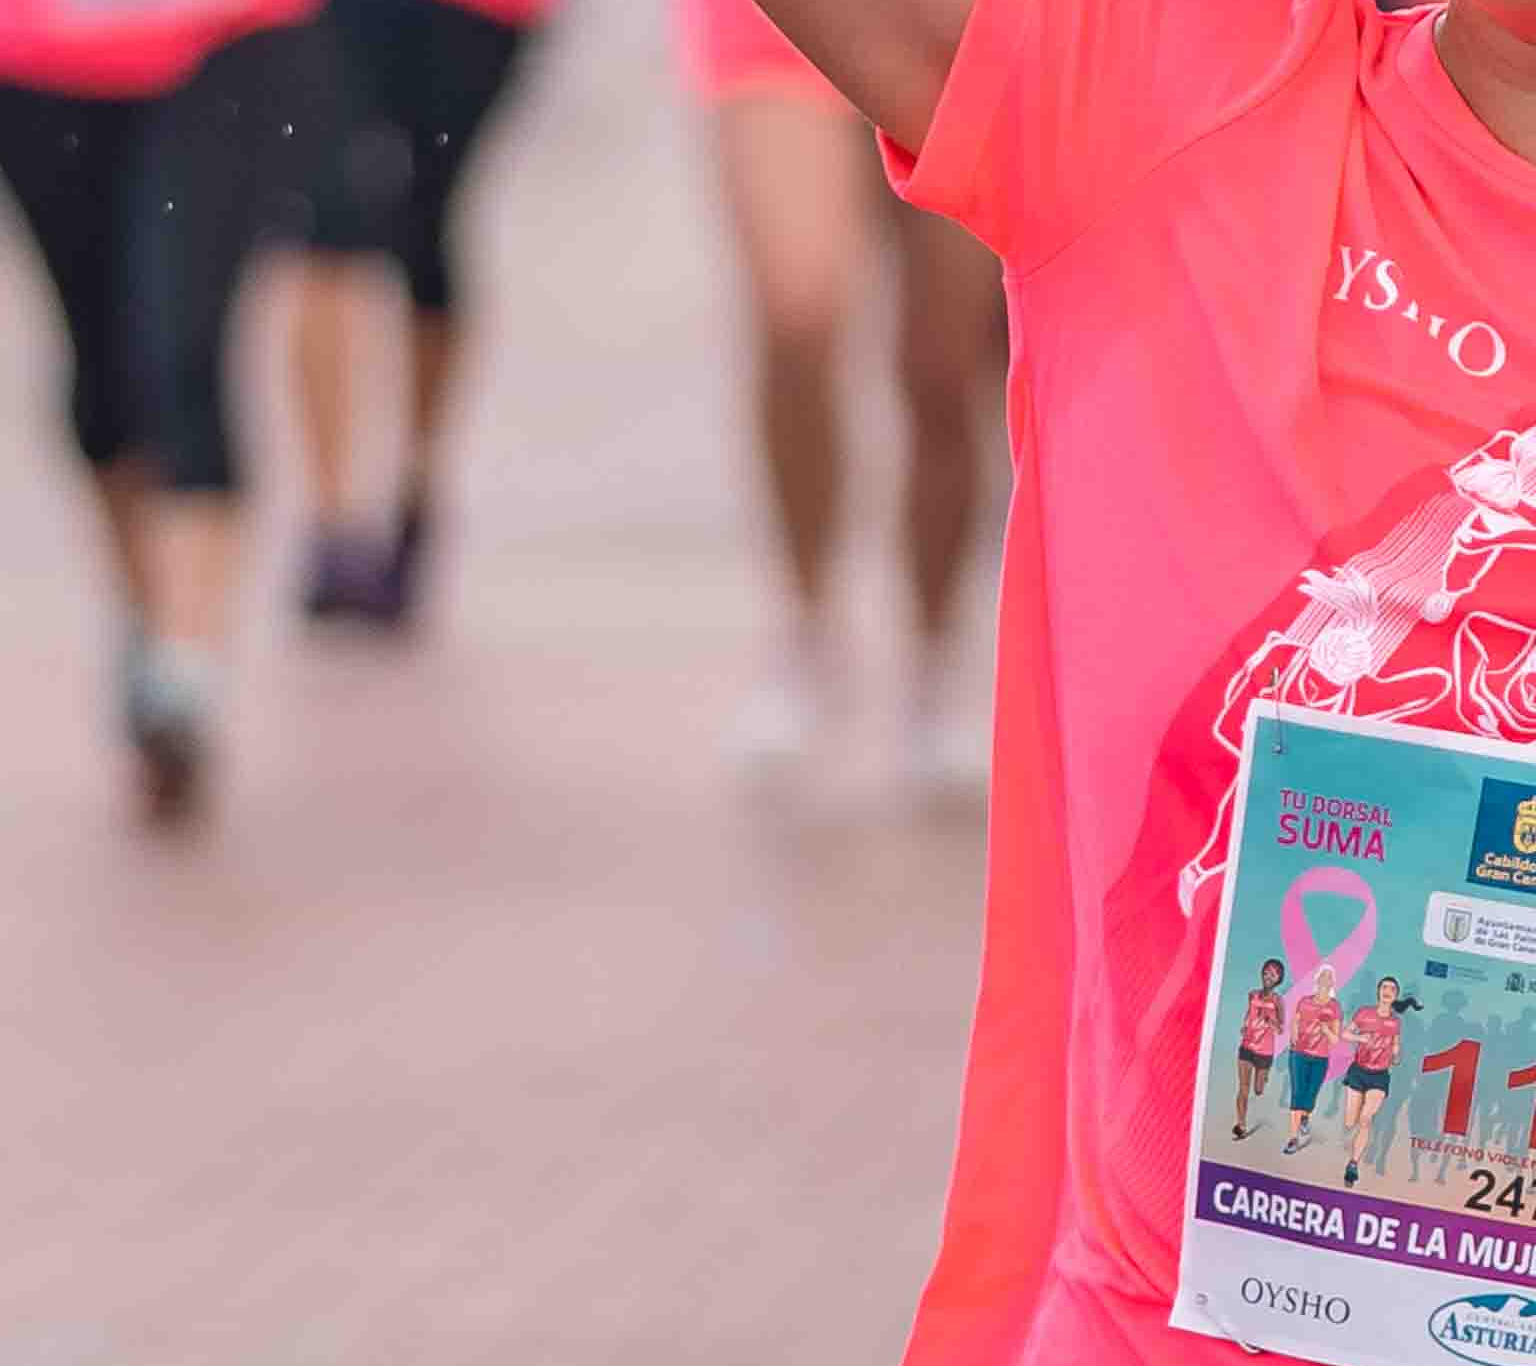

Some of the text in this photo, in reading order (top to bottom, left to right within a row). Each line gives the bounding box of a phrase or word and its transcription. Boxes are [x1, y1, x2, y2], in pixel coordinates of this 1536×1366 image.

[1333, 245, 1507, 377] YSO
[1280, 789, 1392, 827] TU DORSAL
[1277, 813, 1384, 862] SUMA
[1475, 864, 1511, 881] Gran
[1213, 1181, 1345, 1241] CARRERA
[1355, 1212, 1401, 1250] DE
[1407, 1222, 1447, 1260] LA
[1240, 1276, 1351, 1325] OYSHO
